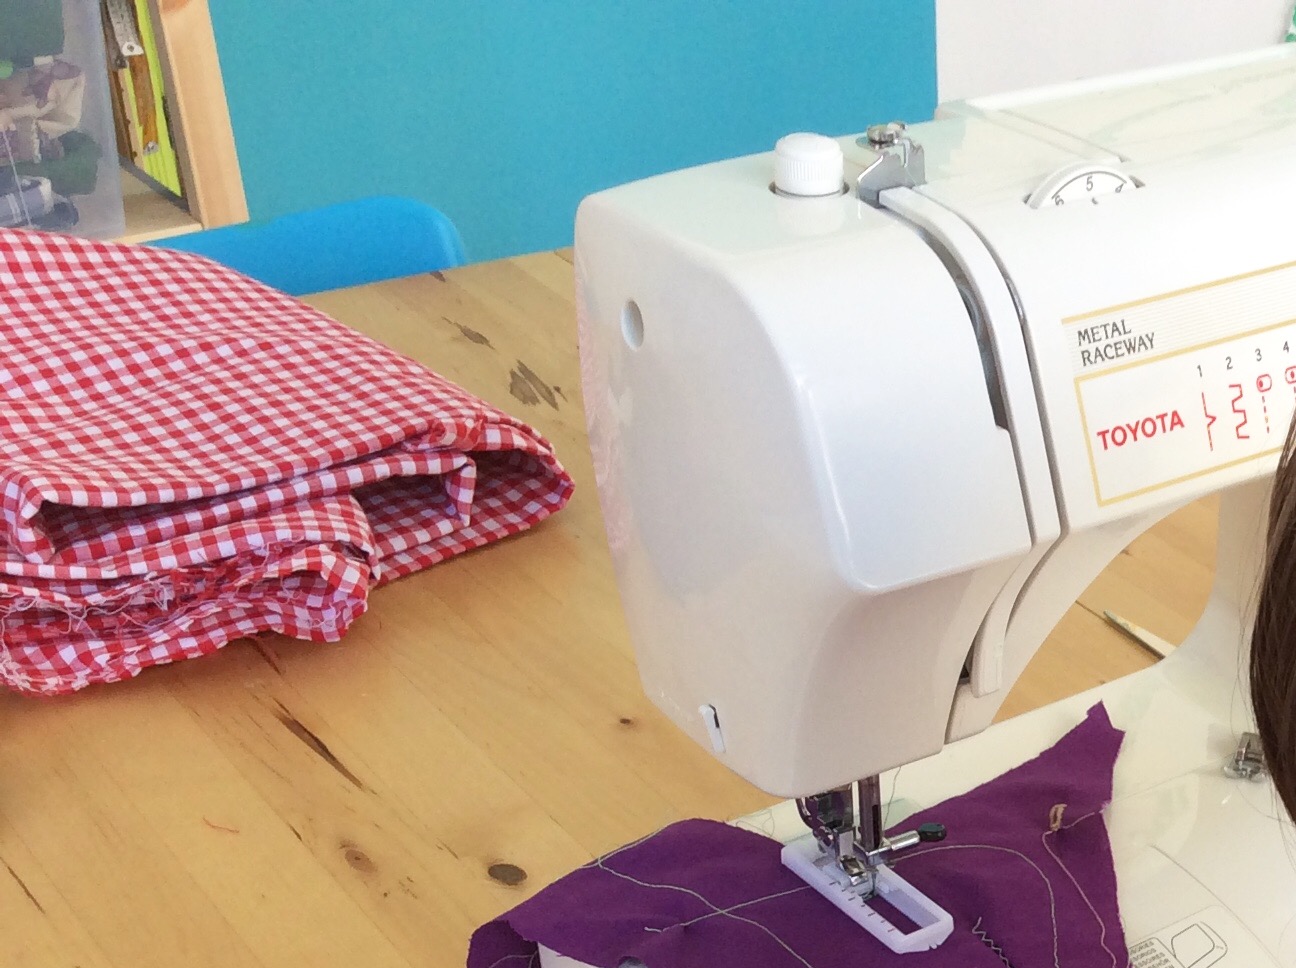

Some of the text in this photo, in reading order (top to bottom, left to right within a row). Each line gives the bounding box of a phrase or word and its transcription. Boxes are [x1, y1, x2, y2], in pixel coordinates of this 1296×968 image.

[1086, 174, 1094, 192] 5
[1077, 318, 1132, 347] METAL
[1080, 332, 1155, 367] RACEWAY
[1196, 364, 1203, 378] 1
[1226, 356, 1234, 370] 2
[1255, 348, 1263, 362] 3
[1283, 341, 1290, 354] 4
[1096, 409, 1186, 451] TOYOTA
